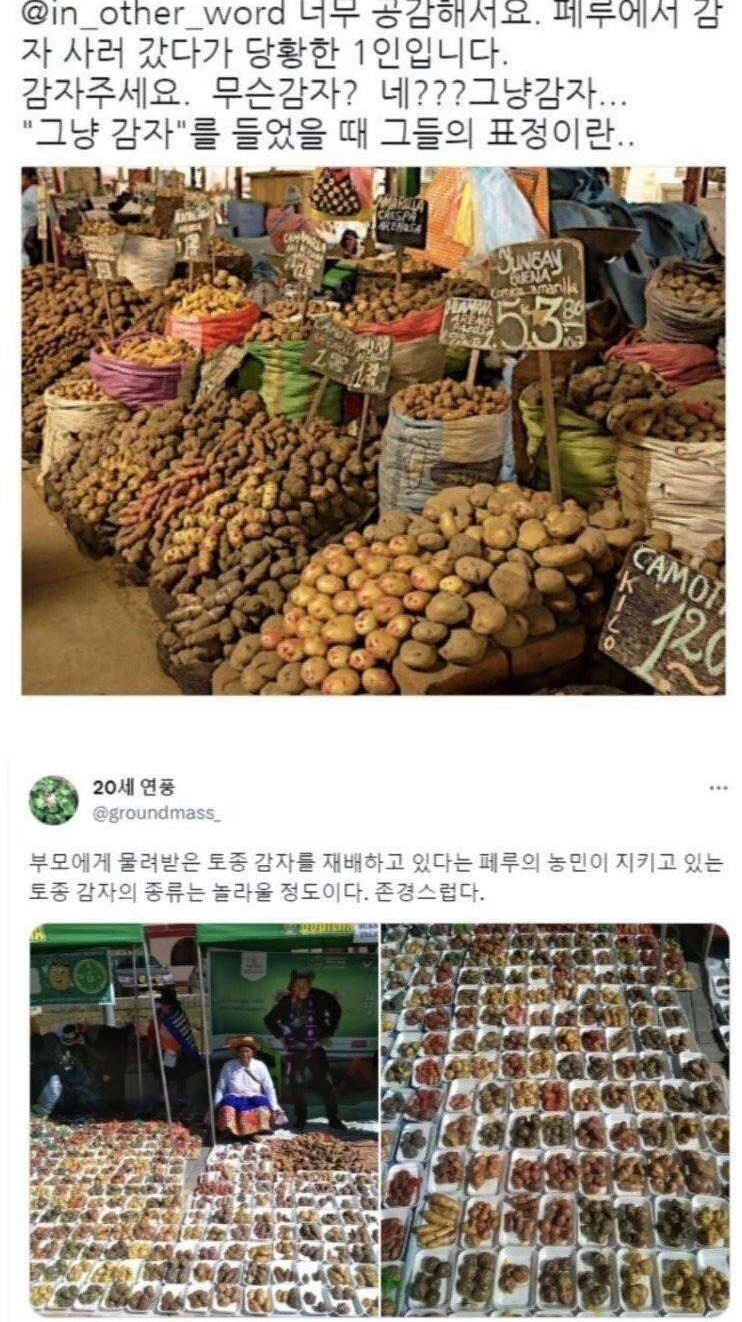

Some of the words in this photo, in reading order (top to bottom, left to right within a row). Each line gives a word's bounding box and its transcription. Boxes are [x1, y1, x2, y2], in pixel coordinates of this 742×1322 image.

[21, 37, 53, 70] 자
[63, 37, 124, 70] 사러
[138, 37, 234, 70] 갔다가
[246, 37, 341, 70] 당황한
[354, 37, 508, 70] 1인입니다.
[22, 77, 190, 110] 감자주세요.
[212, 77, 358, 110] 무슨감자?
[23, 118, 100, 150] "그냥
[111, 118, 221, 150] 감자"를
[232, 118, 328, 150] 들었을
[339, 118, 368, 150] 때
[381, 118, 473, 150] 그들의
[487, 118, 634, 150] 표정이란..
[92, 777, 135, 797] 20세
[140, 777, 176, 797] 연풍
[92, 805, 221, 825] @groundmass_
[28, 852, 111, 873] 부모에게
[117, 852, 201, 873] 물려받은
[207, 852, 248, 873] 토종
[254, 852, 316, 873] 감자를
[322, 852, 405, 873] 재배하고
[412, 852, 474, 873] 있다는
[478, 852, 540, 873] 페루의
[547, 852, 608, 873] 농민이
[616, 852, 677, 873] 지키고
[684, 852, 724, 873] 있는
[28, 882, 70, 903] 토종
[77, 882, 136, 903] 감자의
[144, 882, 206, 903] 종류는
[211, 882, 274, 903] 놀라울
[280, 882, 369, 903] 정도이다.
[374, 882, 485, 903] 존경스럽다.
